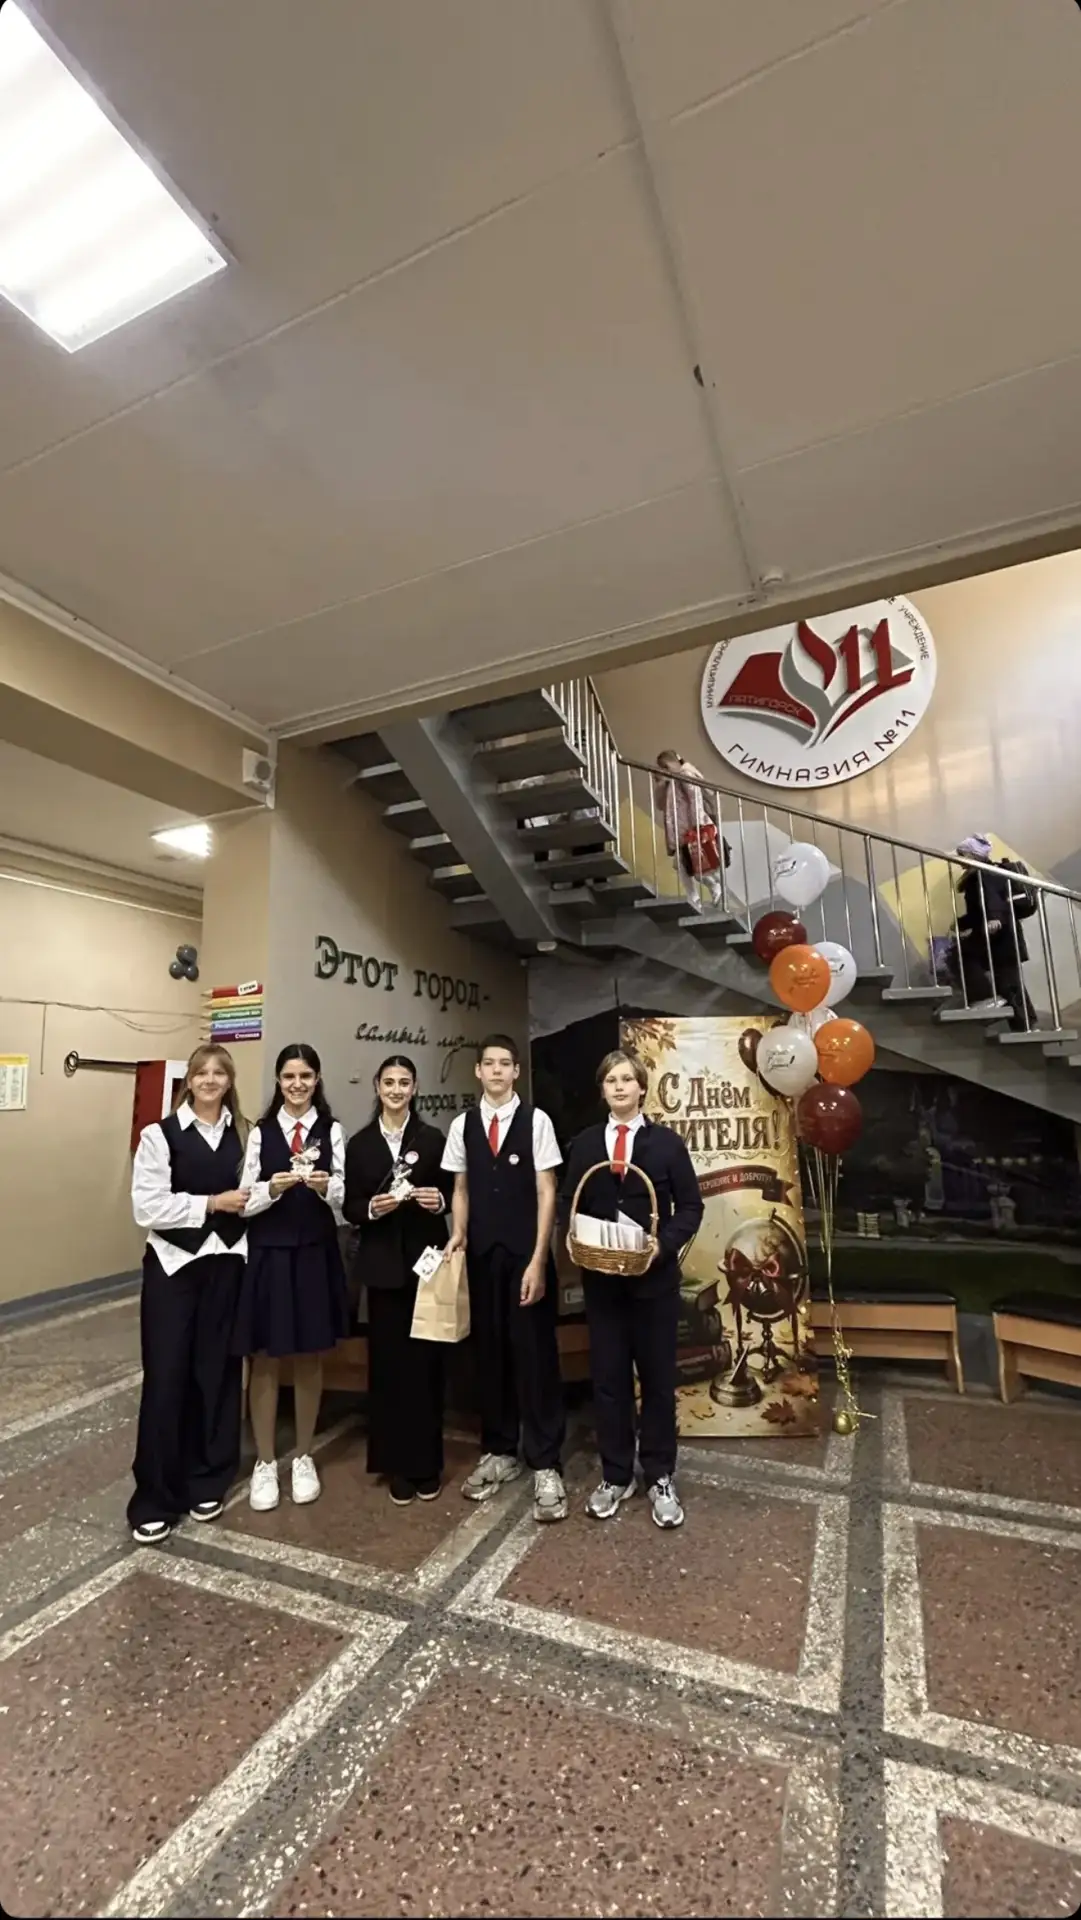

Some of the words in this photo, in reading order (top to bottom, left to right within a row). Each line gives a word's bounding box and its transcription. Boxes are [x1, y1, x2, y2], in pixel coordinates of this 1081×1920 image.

[728, 695, 802, 717] ПЯТИГОРСК
[727, 743, 870, 783] ГИМНАЗИЯ
[314, 935, 399, 992] Этот
[657, 1072, 682, 1114] С
[685, 1077, 752, 1118] Днём
[652, 1110, 781, 1151] ЧИТЕЛЯ!
